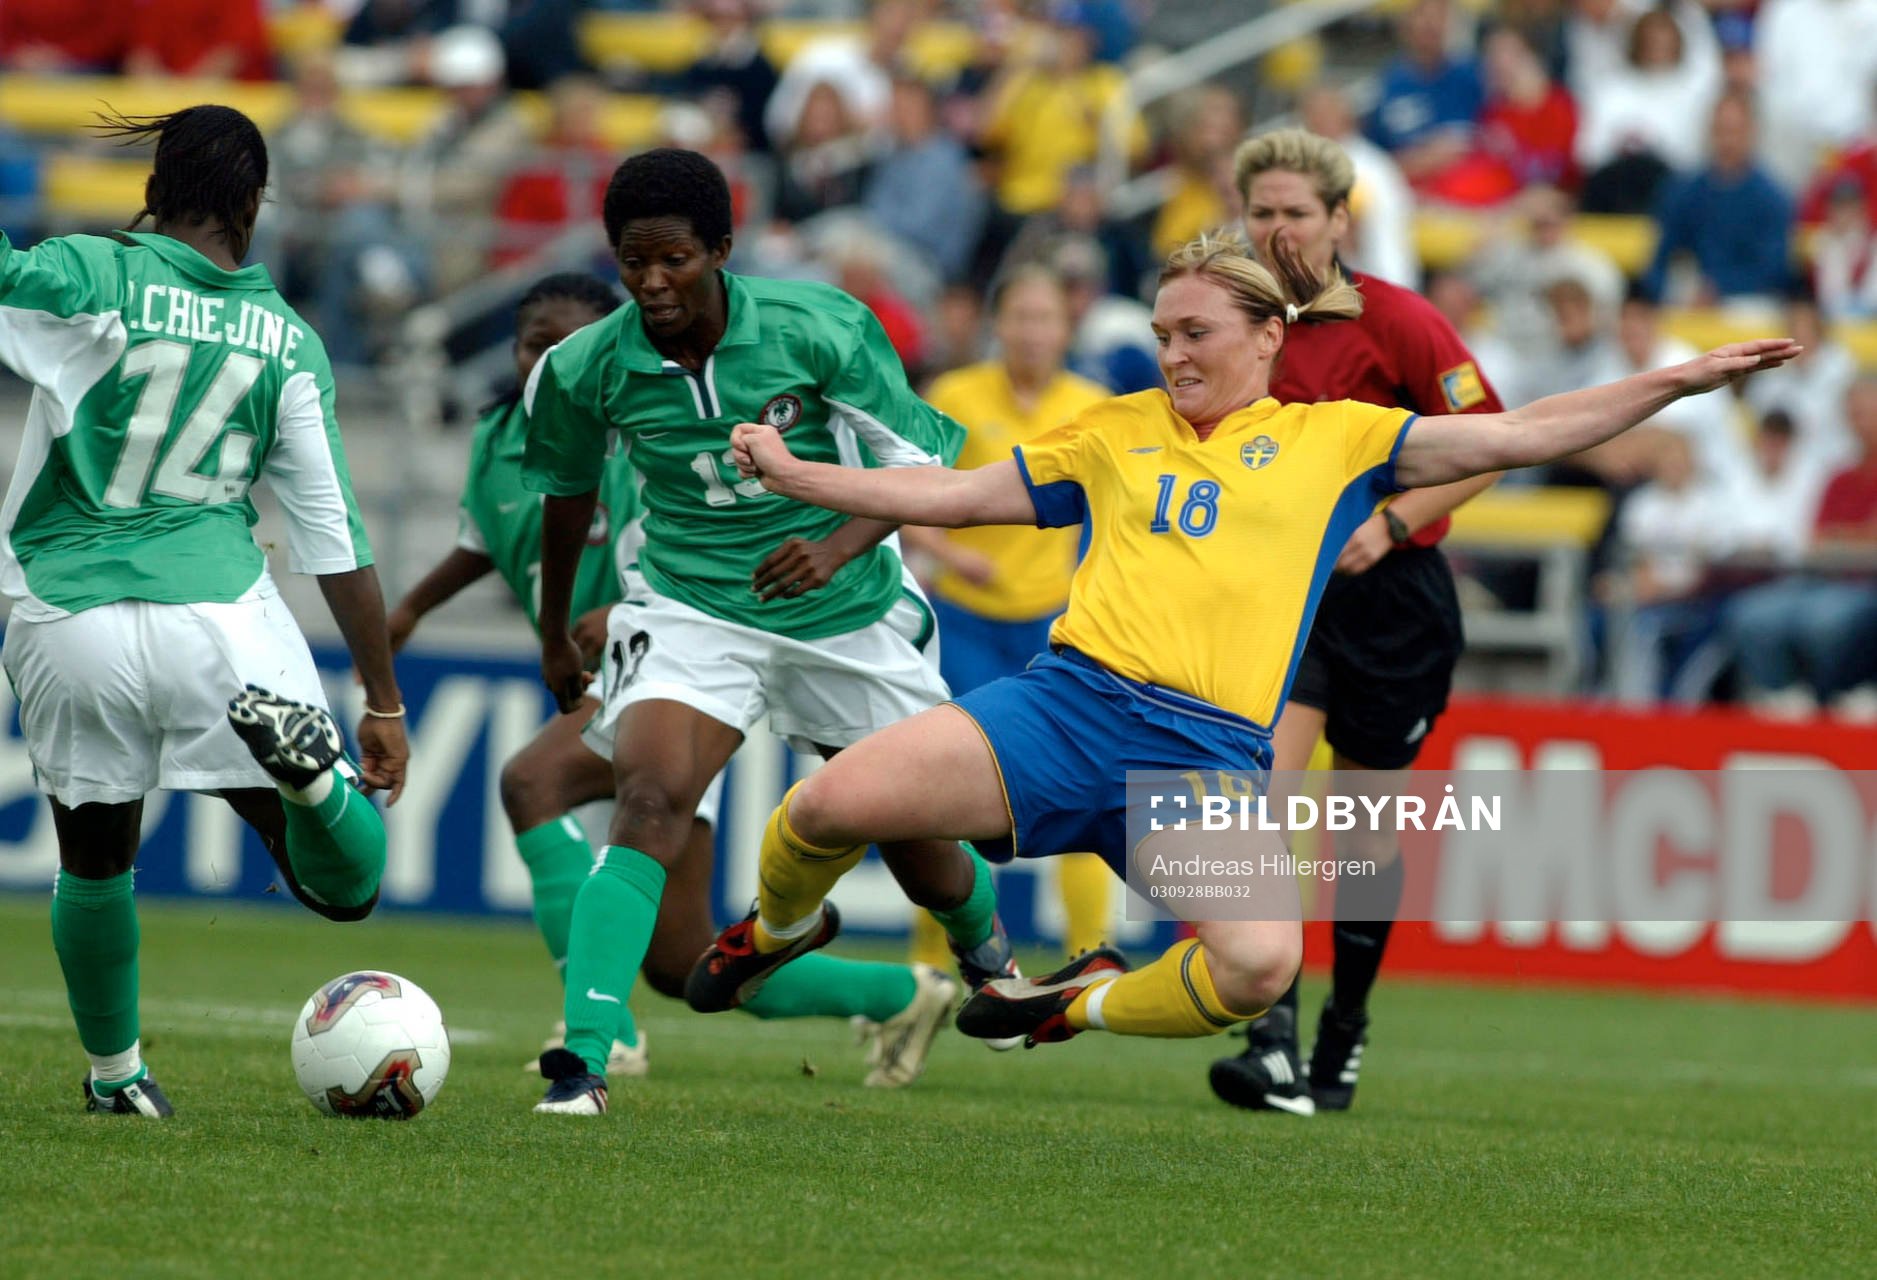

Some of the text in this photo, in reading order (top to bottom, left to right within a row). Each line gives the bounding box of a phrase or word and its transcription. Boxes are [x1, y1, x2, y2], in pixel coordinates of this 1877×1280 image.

[104, 337, 266, 509] 14
[1149, 474, 1221, 539] 18
[1432, 734, 1877, 965] McD
